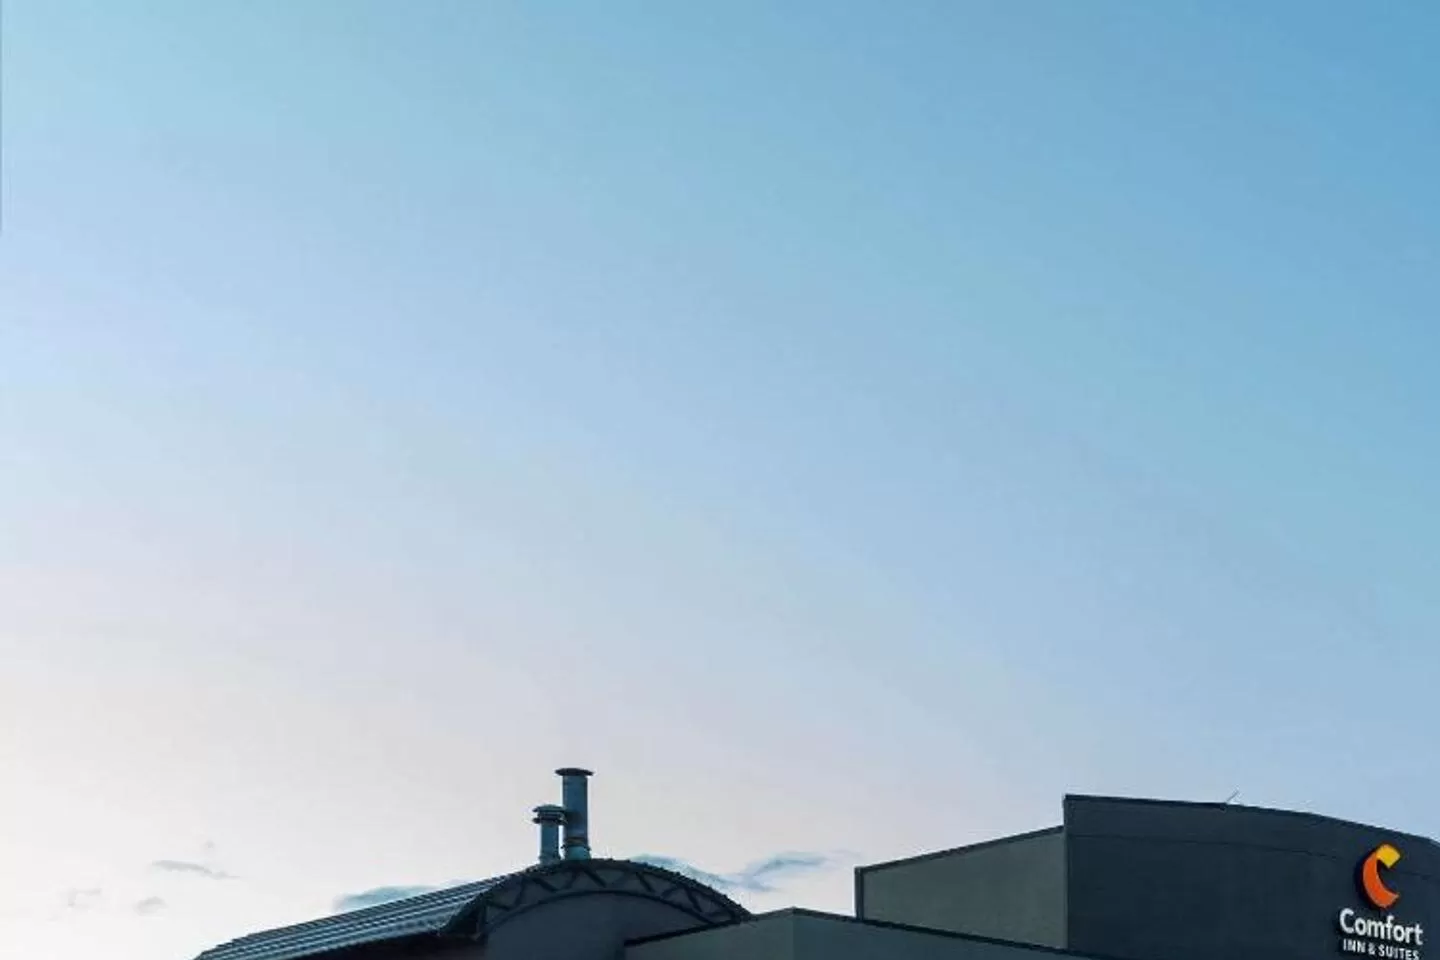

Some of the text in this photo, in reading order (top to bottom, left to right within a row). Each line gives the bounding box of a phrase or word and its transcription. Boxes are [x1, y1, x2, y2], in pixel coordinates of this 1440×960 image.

[1339, 908, 1424, 946] Comfort
[1343, 939, 1366, 953] INN
[1368, 943, 1376, 955] &
